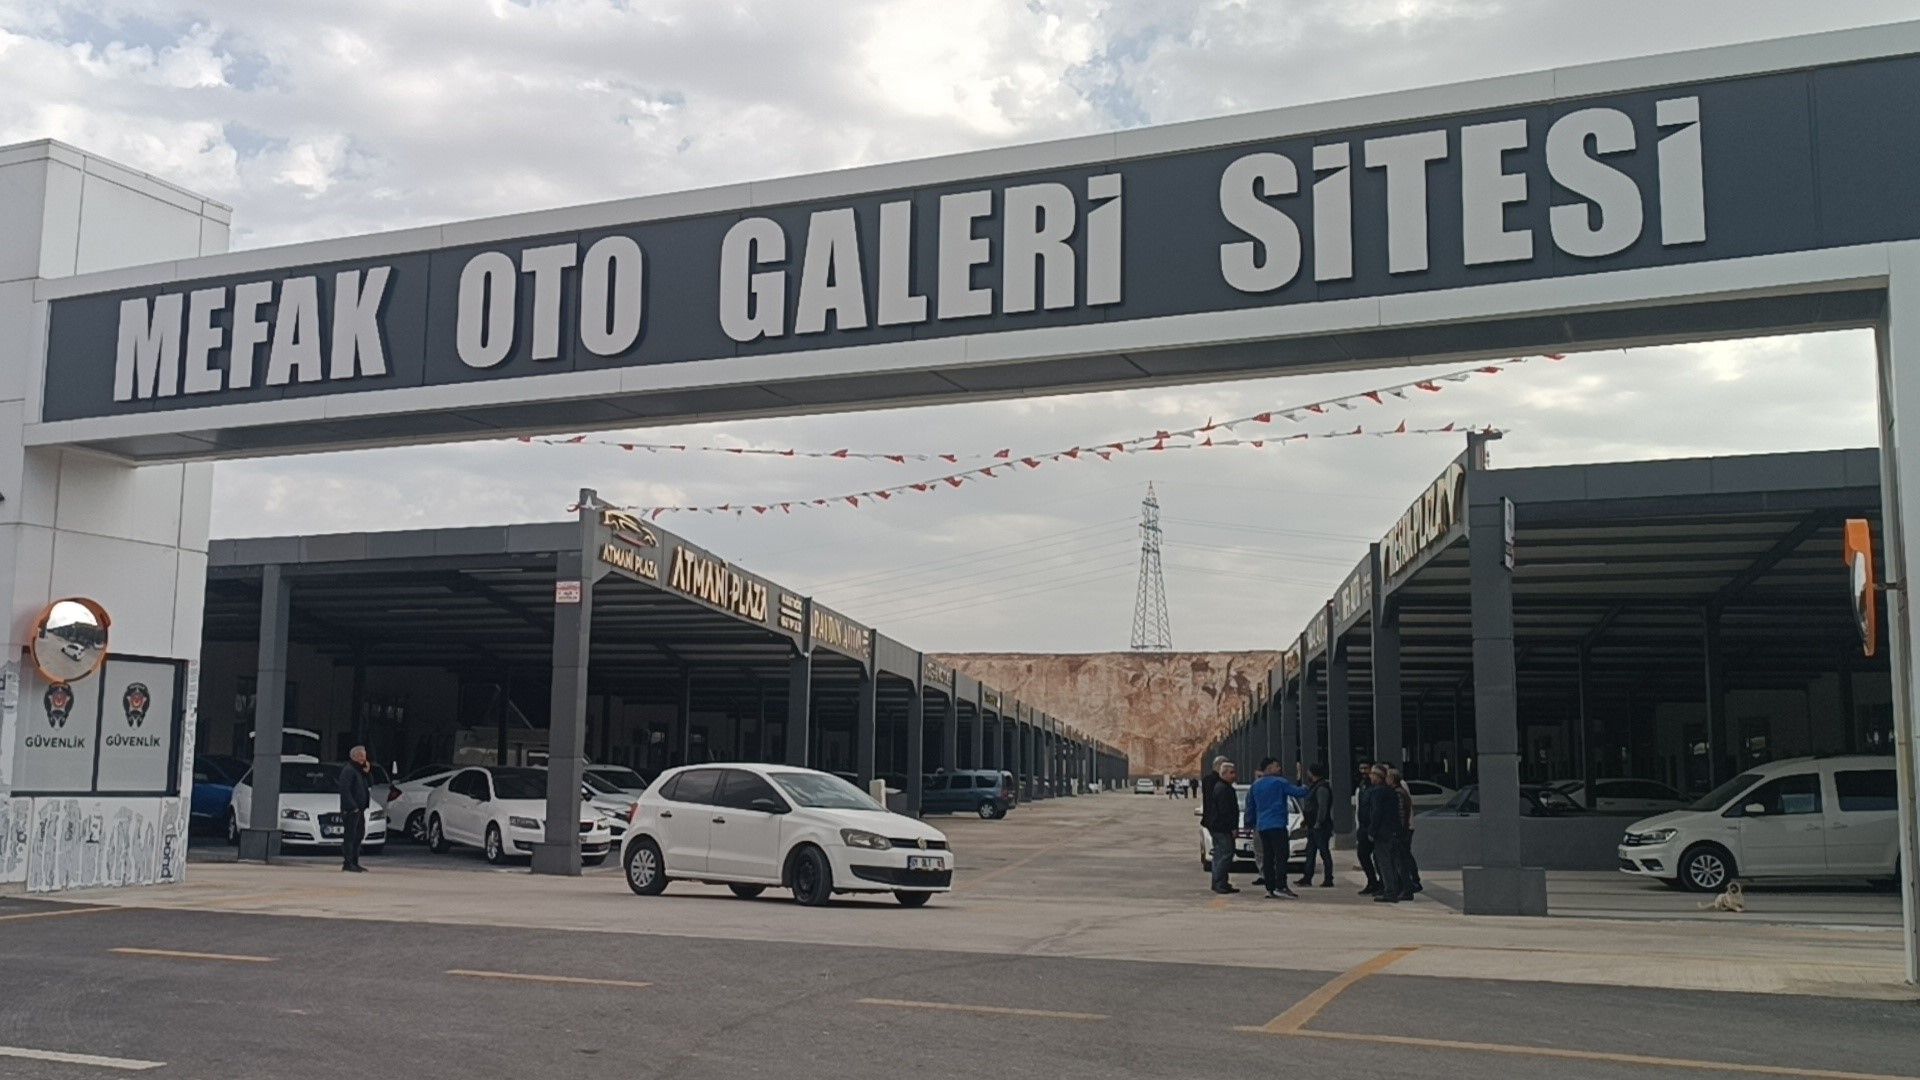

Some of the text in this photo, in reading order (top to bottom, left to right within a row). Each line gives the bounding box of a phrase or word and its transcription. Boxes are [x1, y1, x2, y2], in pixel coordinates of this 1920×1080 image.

[113, 96, 1706, 402] MEFAK OTO GALERİ SİTESİ
[634, 554, 659, 580] PLAZA
[730, 573, 768, 622] PLAZA
[25, 734, 85, 748] GÜVENLİK
[105, 733, 160, 747] GÜVENLİK
